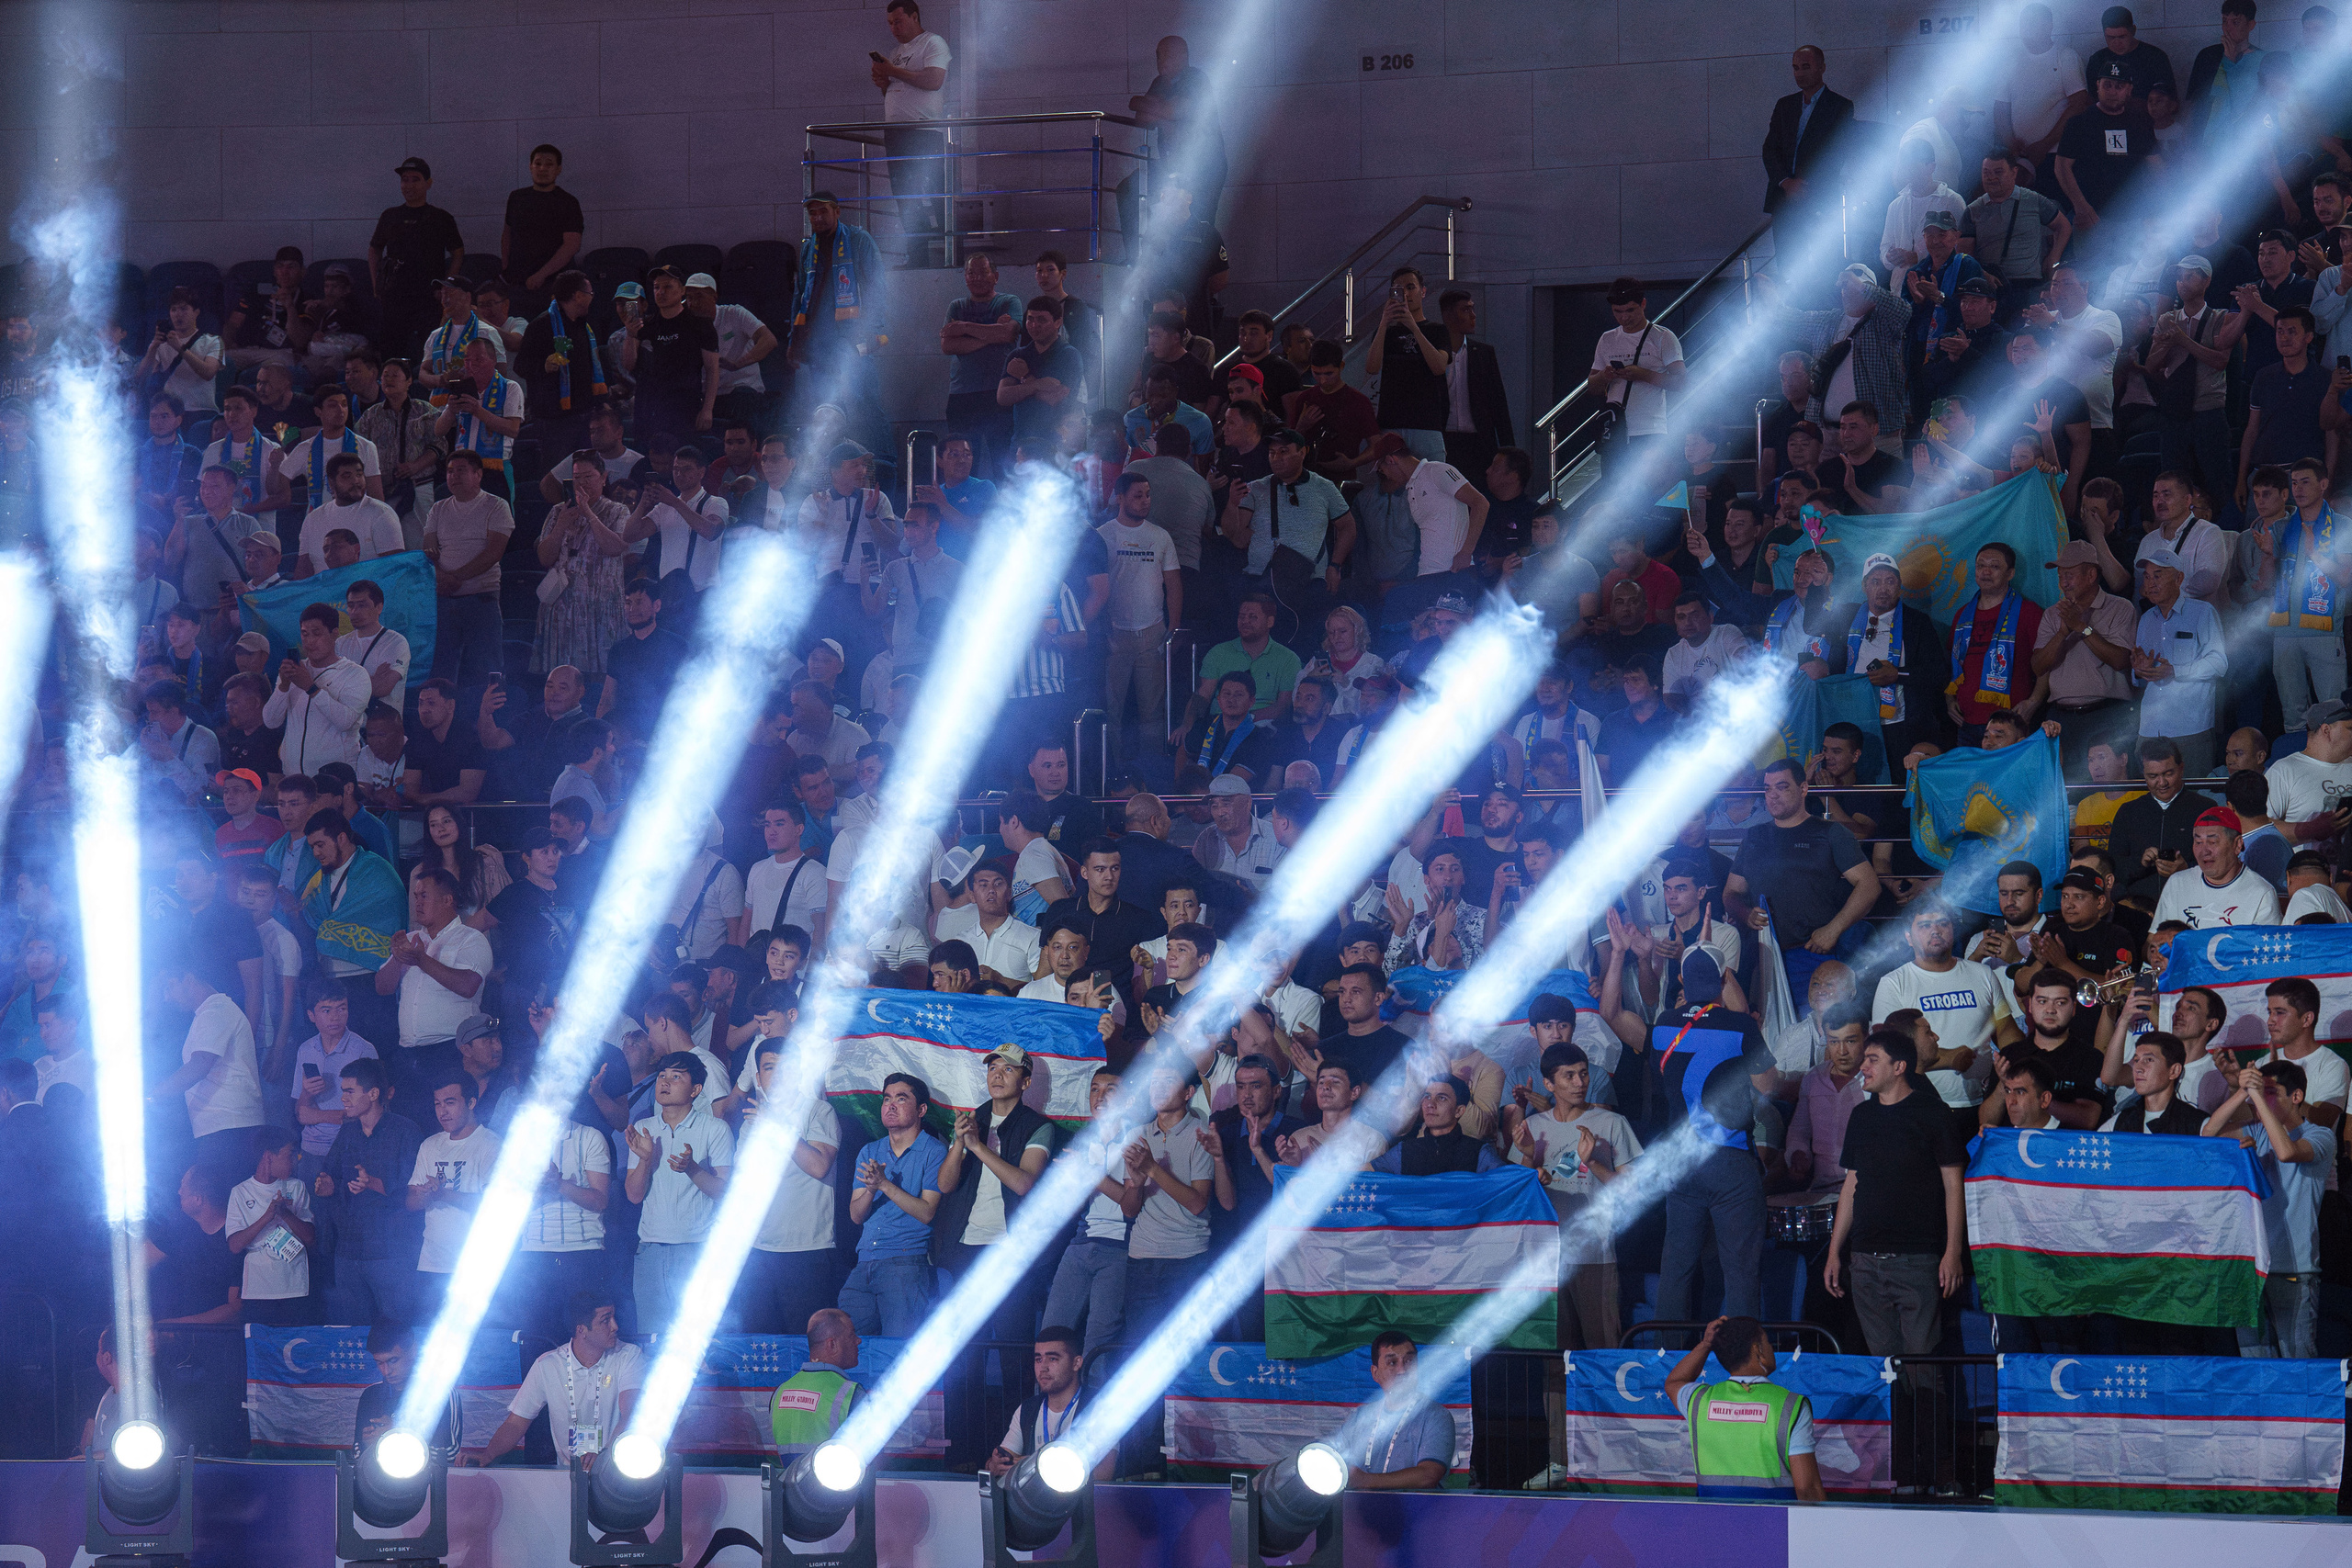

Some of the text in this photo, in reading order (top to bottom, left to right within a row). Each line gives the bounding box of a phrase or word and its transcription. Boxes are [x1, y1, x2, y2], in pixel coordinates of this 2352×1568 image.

[1919, 16, 1974, 35] B 207
[1363, 53, 1414, 72] B 206
[2110, 63, 2120, 76] LA
[1867, 556, 1892, 567] FILA
[1922, 992, 1975, 1010] STROBAR
[1713, 1406, 1732, 1416] MILLIY
